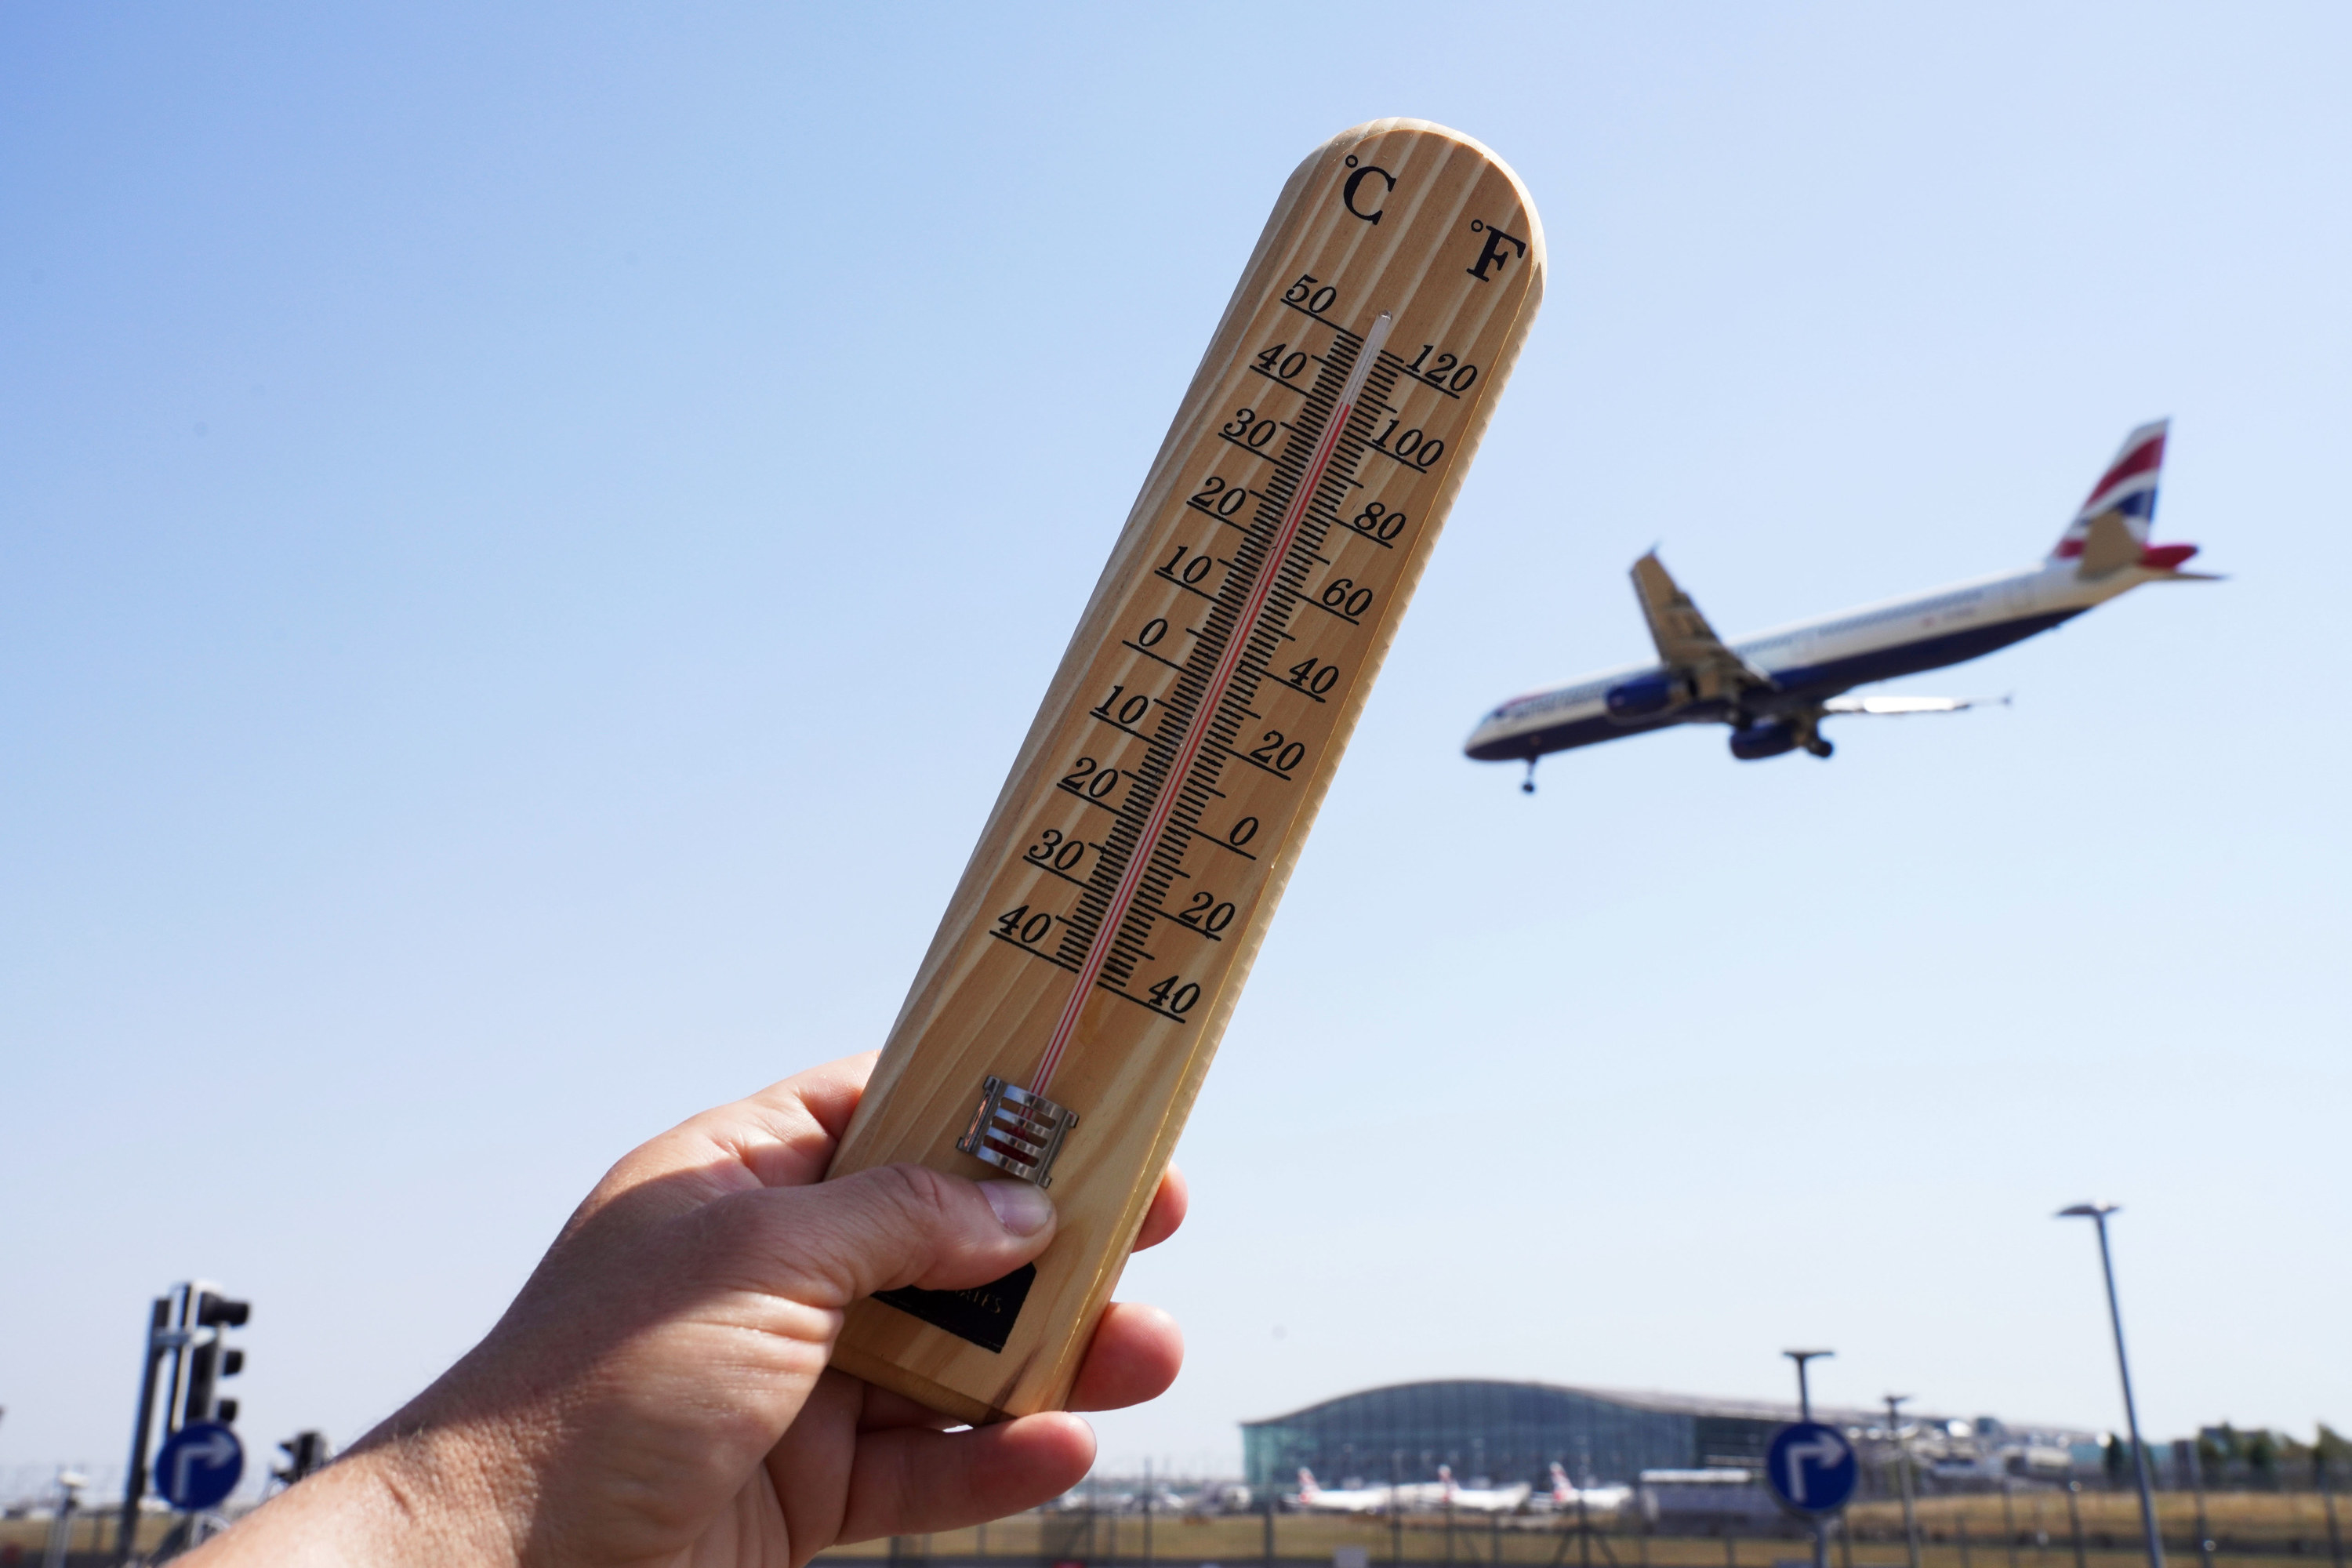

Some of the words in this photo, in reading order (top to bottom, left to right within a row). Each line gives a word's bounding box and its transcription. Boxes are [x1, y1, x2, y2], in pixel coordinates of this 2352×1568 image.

[1286, 274, 1336, 313] 50
[1258, 344, 1307, 379] 40
[1406, 345, 1477, 392] 120
[1223, 408, 1276, 447] 30
[1372, 419, 1444, 466] 100
[1192, 477, 1246, 516] 20
[1354, 502, 1406, 540] 80
[1159, 546, 1211, 583] 10
[1323, 579, 1373, 616] 60
[1139, 619, 1168, 647] 0
[1289, 658, 1339, 694] 40
[1094, 686, 1148, 724] 10
[1250, 730, 1305, 771] 20
[1062, 757, 1118, 798] 20
[1029, 829, 1084, 870] 30
[1229, 817, 1258, 846] 0
[998, 905, 1051, 943] 40
[1178, 891, 1236, 932] 20
[1149, 975, 1200, 1014] 40
